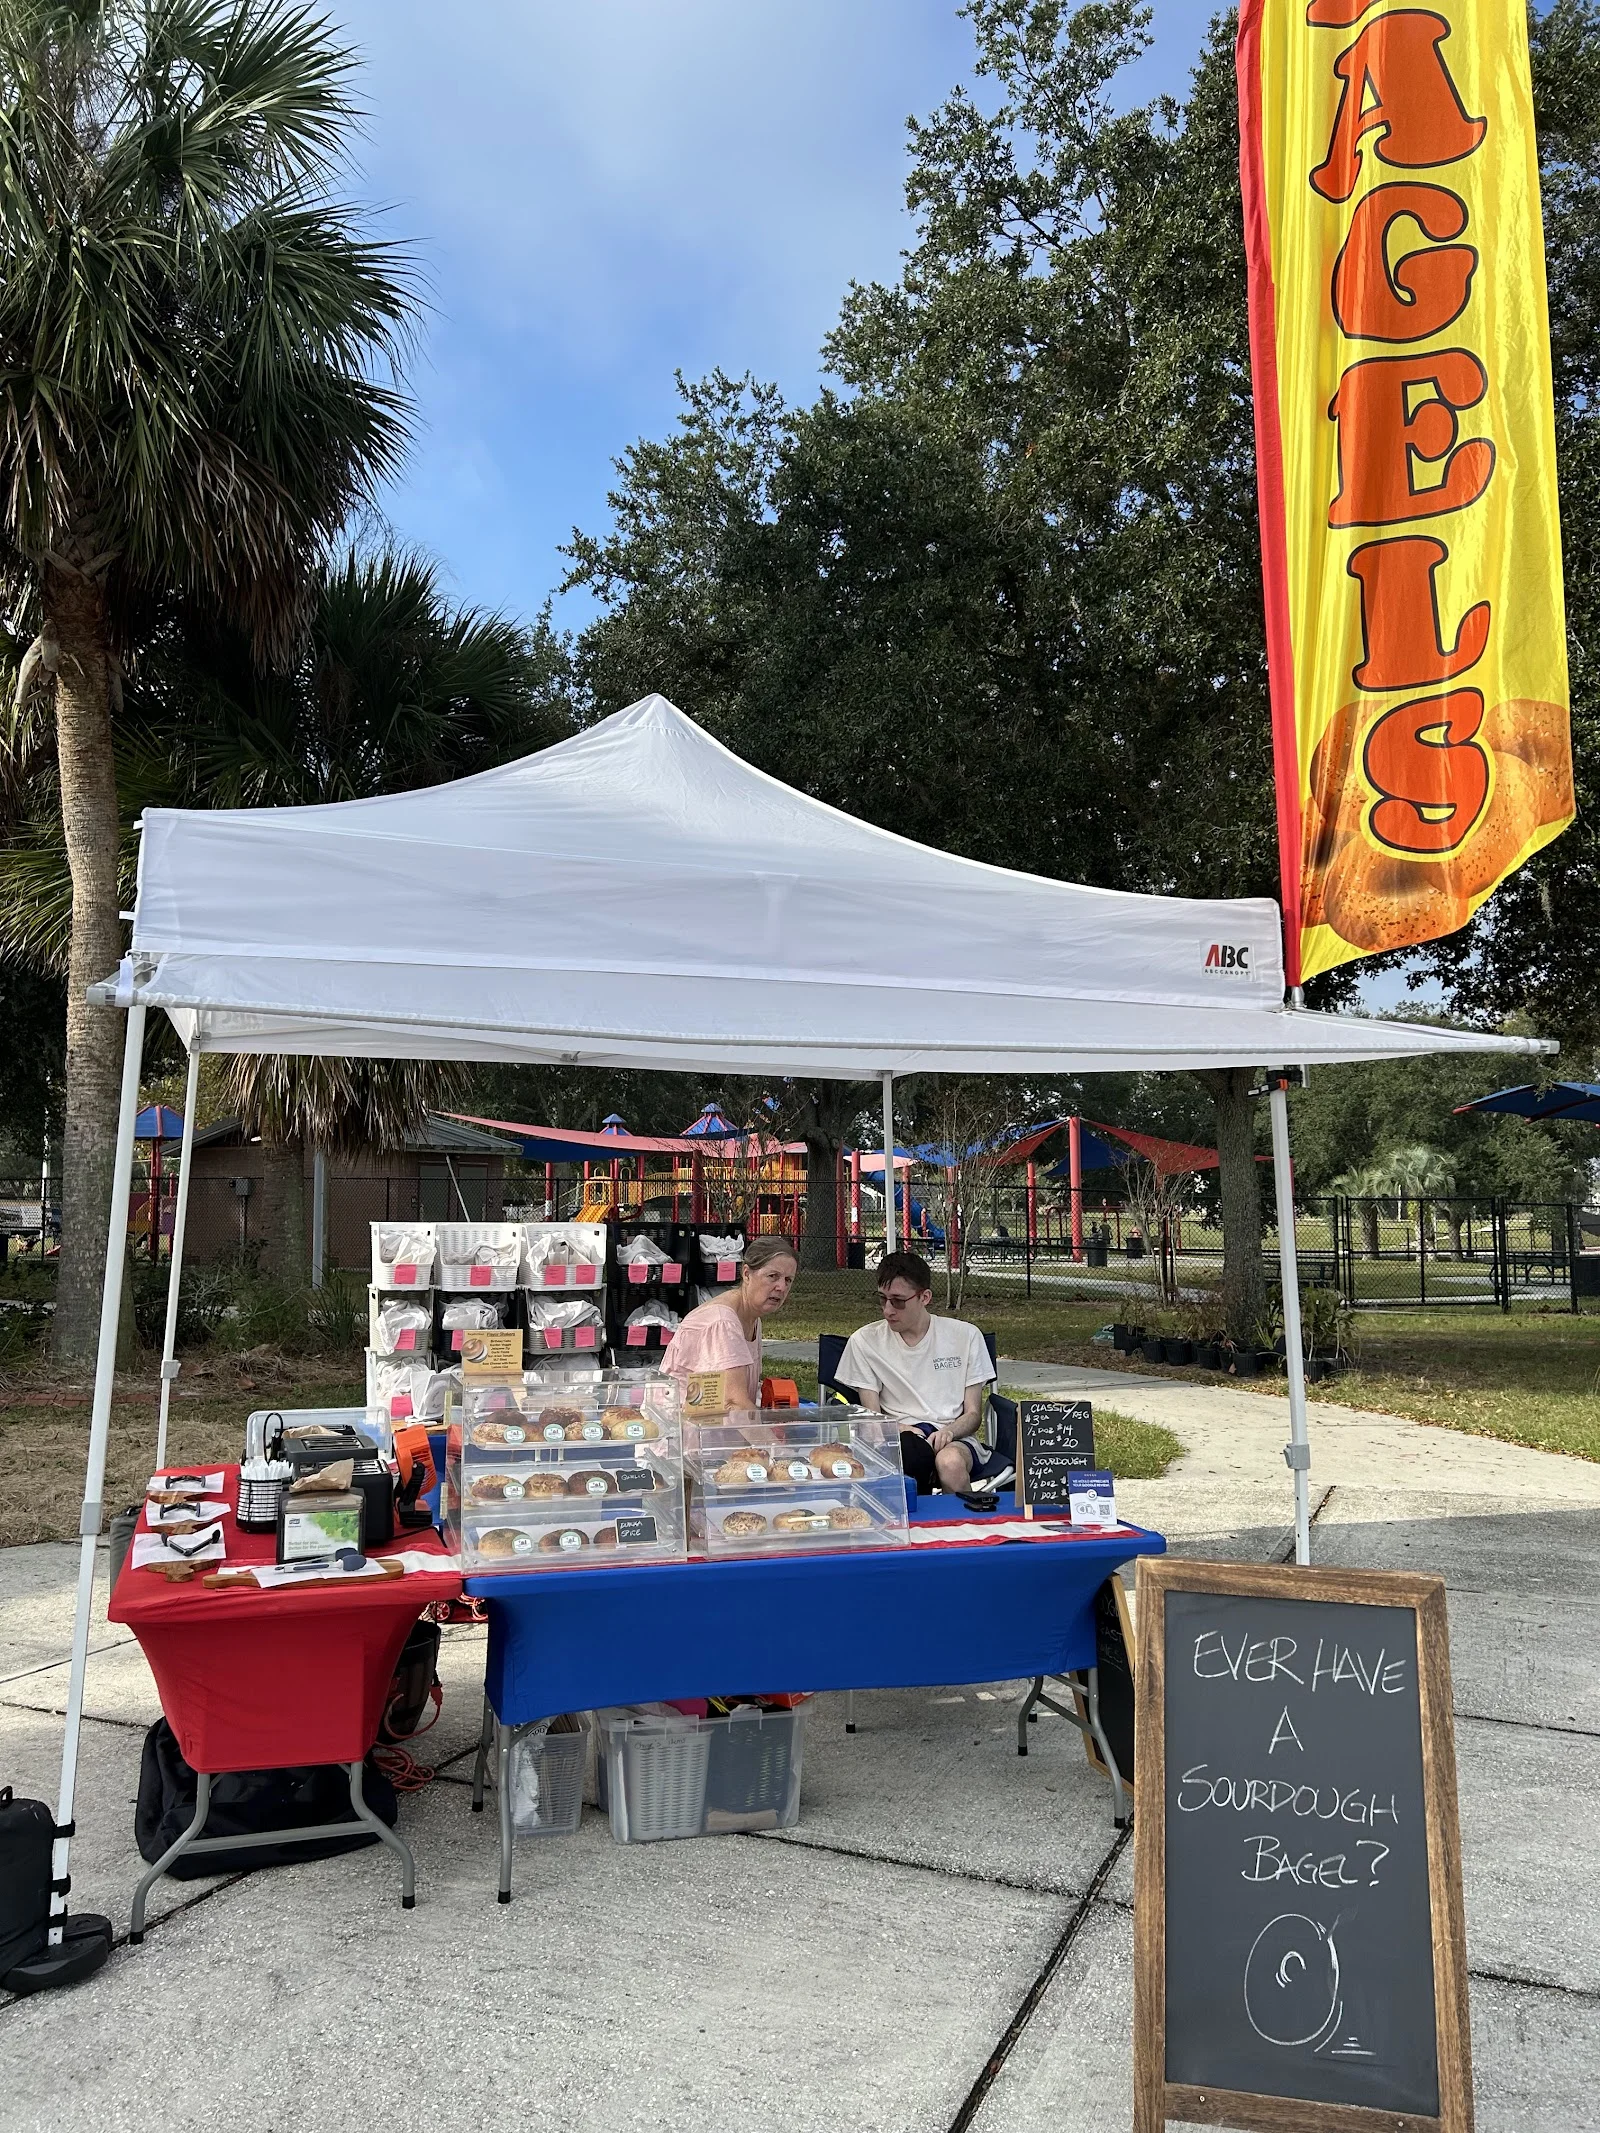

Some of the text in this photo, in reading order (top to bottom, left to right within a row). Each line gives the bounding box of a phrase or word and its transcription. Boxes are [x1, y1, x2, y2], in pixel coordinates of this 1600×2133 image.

[1307, 0, 1496, 853] AGELS
[1205, 944, 1249, 969] ABC
[934, 1359, 962, 1370] BAGELS
[1032, 1456, 1088, 1466] SOURDOUGH
[1193, 1630, 1407, 1696] EVER HAVE
[1268, 1704, 1305, 1755] A
[1177, 1763, 1400, 1826] SOURDOUGH
